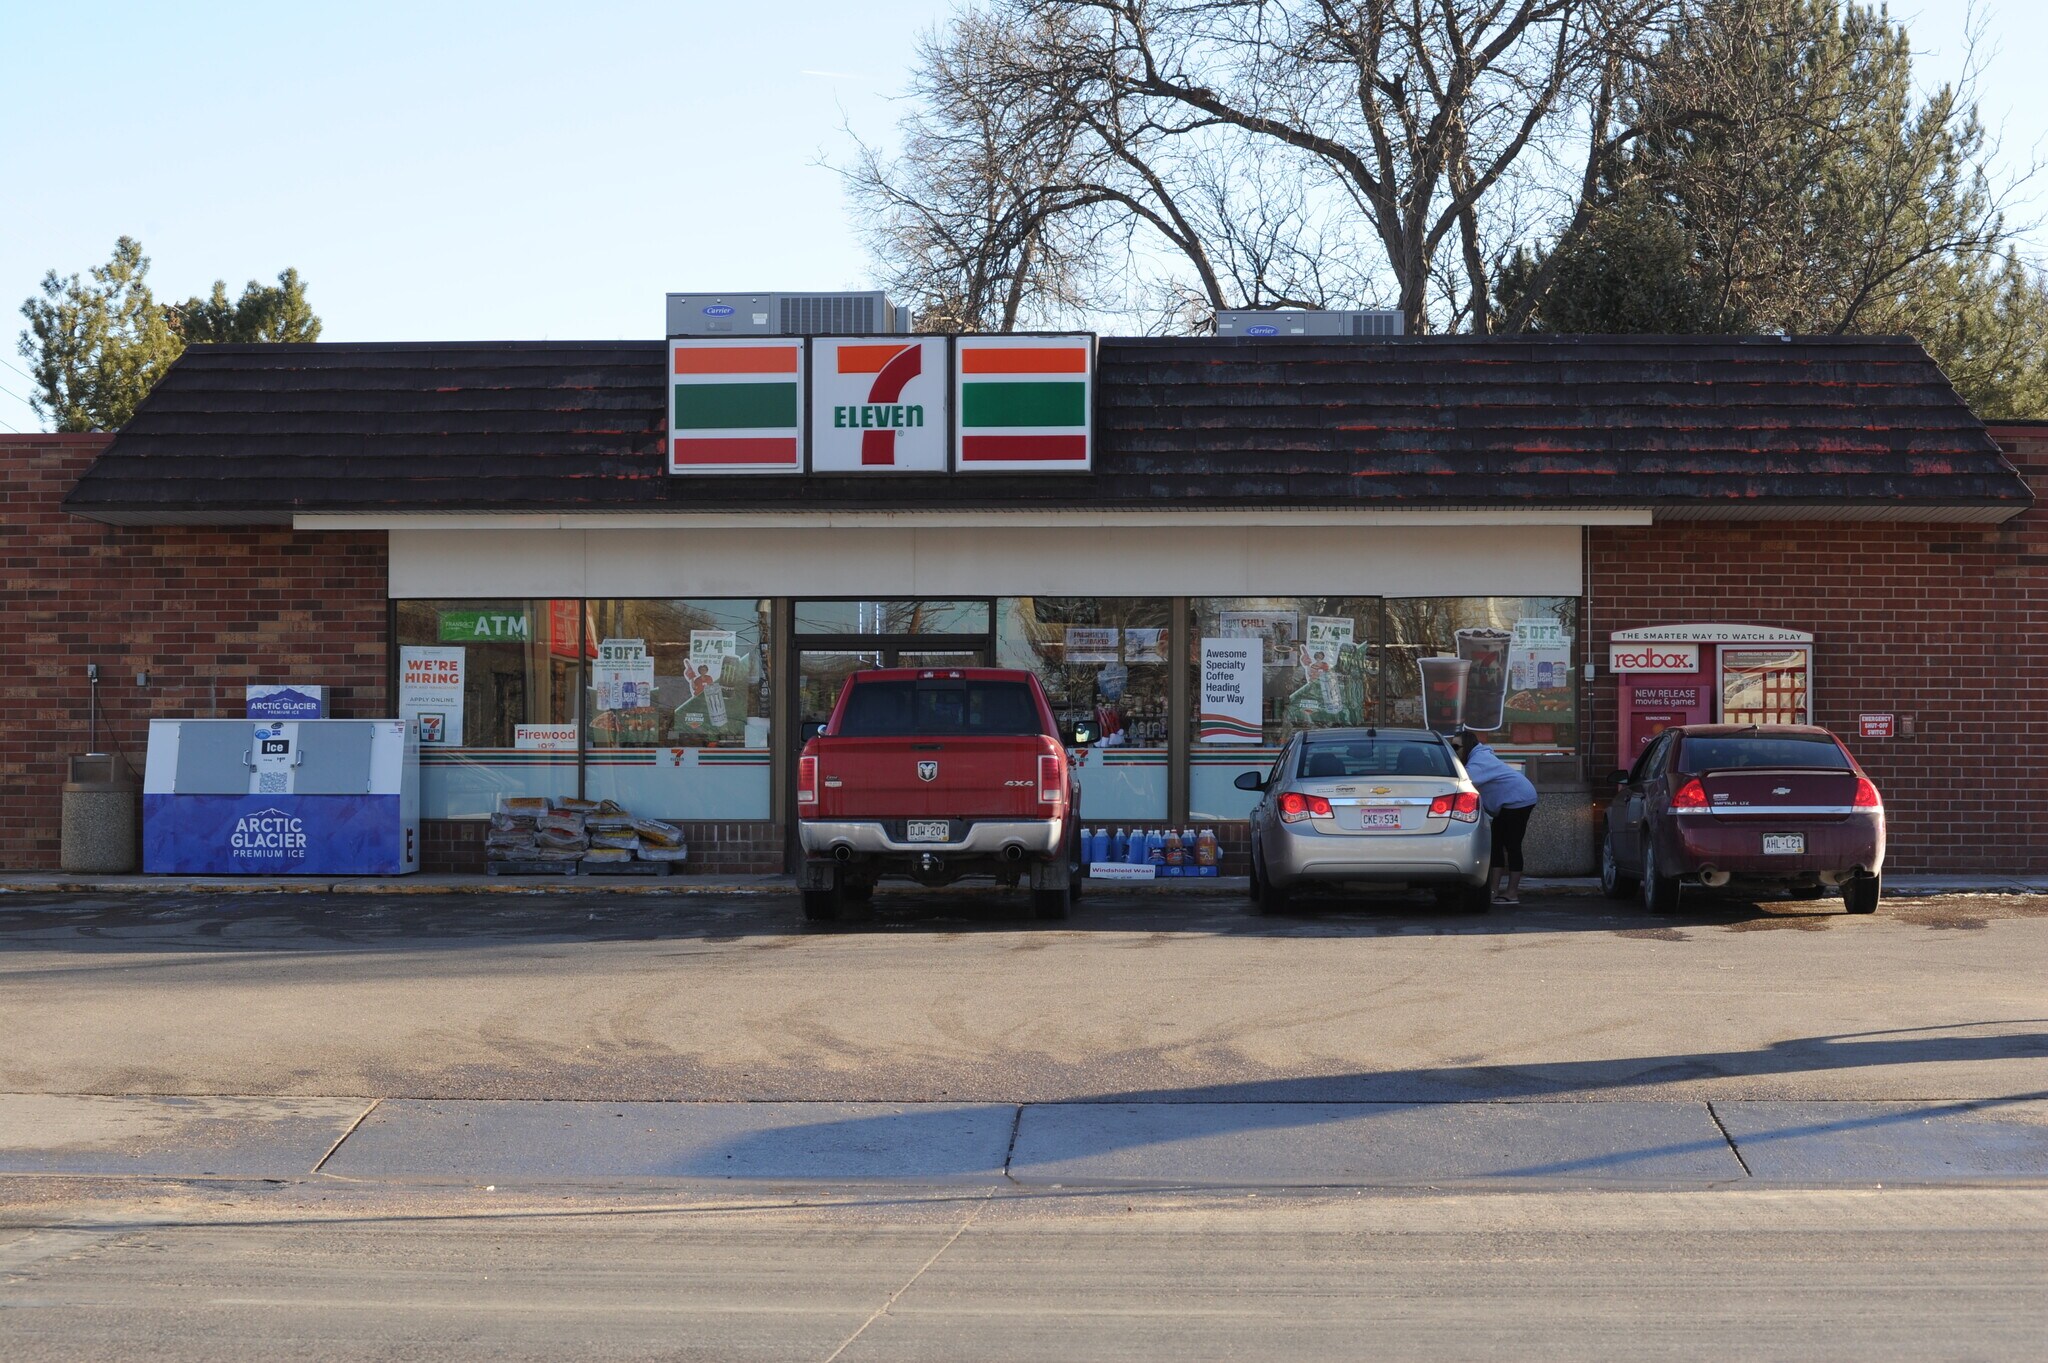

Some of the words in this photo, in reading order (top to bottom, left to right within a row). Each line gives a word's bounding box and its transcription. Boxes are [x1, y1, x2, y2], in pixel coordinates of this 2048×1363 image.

[706, 307, 732, 316] Carrier
[838, 344, 922, 466] 7
[474, 616, 528, 636] ATM
[614, 646, 642, 660] OFF
[1206, 649, 1247, 658] Awesome
[1206, 660, 1246, 671] Specialty
[405, 673, 459, 684] HIRING
[1206, 672, 1234, 680] Coffee
[1206, 683, 1240, 694] Heading
[1206, 694, 1225, 703] Your
[1227, 694, 1244, 705] Way
[1671, 699, 1695, 707] games
[517, 729, 575, 739] Firewood
[267, 743, 283, 752] Ice
[1364, 815, 1377, 824] CKE
[1385, 814, 1398, 824] 534
[235, 818, 302, 832] ARCTIC
[231, 833, 307, 848] GLACIER
